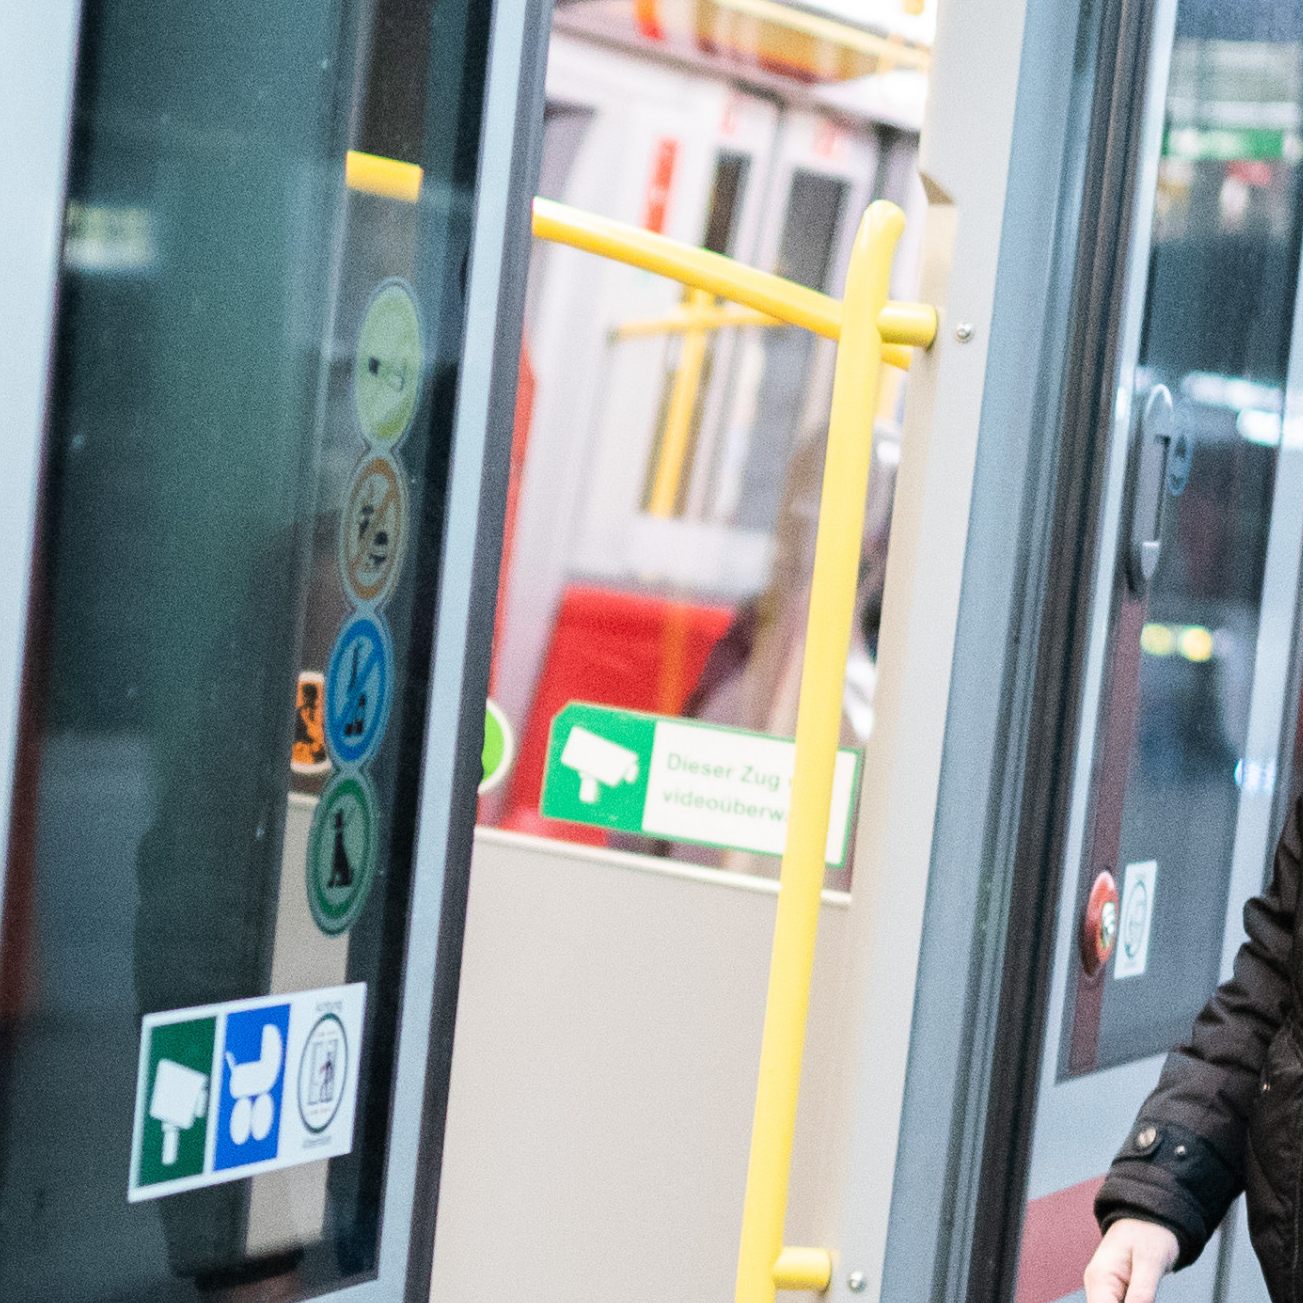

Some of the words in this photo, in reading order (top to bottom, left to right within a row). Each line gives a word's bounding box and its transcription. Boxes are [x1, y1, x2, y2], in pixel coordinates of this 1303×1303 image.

[667, 752, 733, 779] Dieser
[740, 765, 780, 791] Zug
[663, 790, 788, 821] videoüberw
